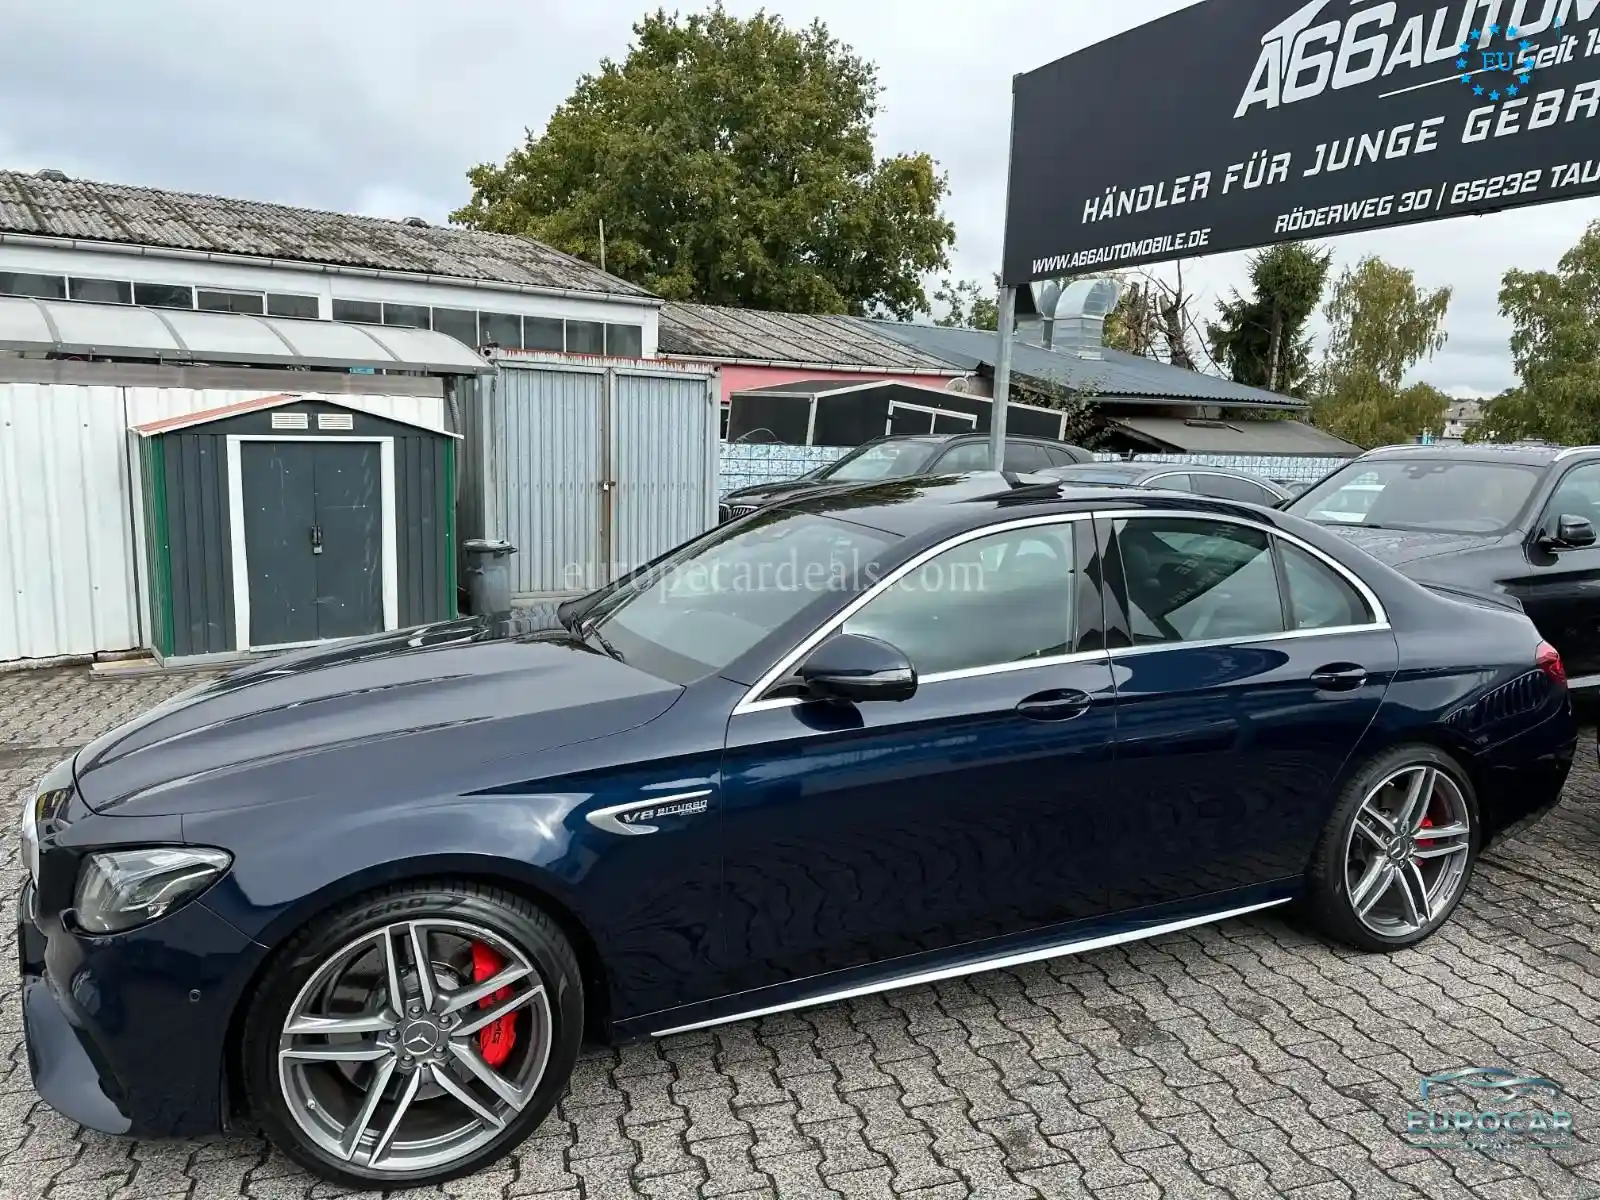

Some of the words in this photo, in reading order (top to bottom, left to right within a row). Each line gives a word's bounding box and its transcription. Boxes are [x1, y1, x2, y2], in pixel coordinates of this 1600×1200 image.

[1512, 34, 1579, 76] Seit
[1081, 170, 1212, 224] HÄNDLER
[1221, 148, 1292, 195] FÜR
[1302, 115, 1446, 178] JUNGE
[1460, 78, 1600, 144] GEBR
[1274, 194, 1394, 234] RÖDERWEG
[1397, 188, 1433, 213] 30
[1450, 169, 1542, 205] 65232
[1031, 227, 1212, 275] WWW.A66AUTOMOBILE.DE
[623, 809, 655, 824] V8
[656, 799, 708, 817] BITURBO
